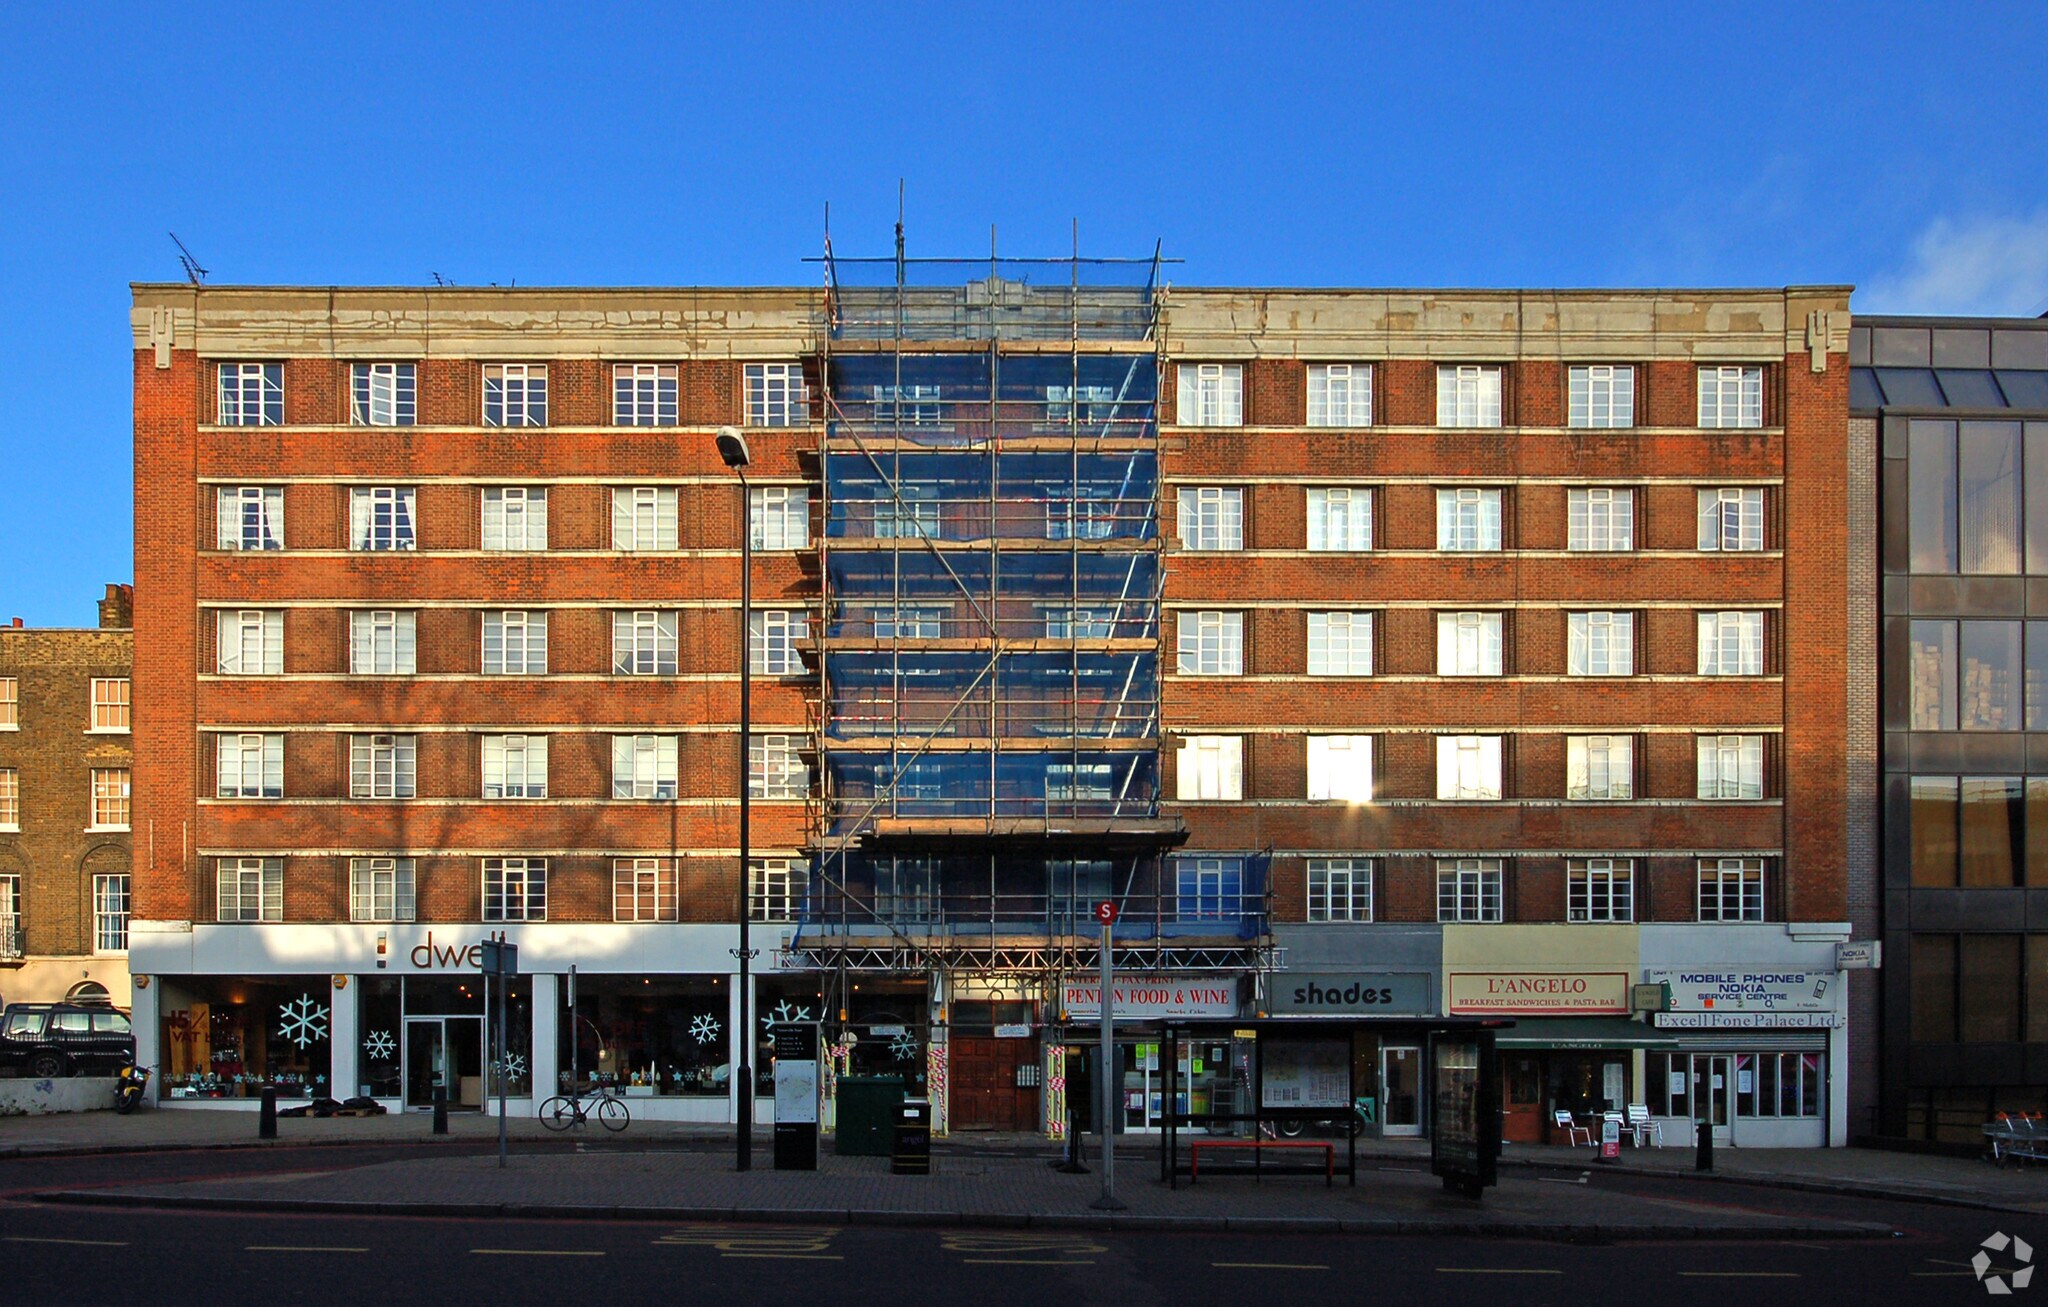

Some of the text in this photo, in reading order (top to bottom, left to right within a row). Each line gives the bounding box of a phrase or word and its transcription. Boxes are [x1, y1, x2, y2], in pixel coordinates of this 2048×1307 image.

[1101, 904, 1111, 918] S
[411, 930, 505, 968] dwe
[1681, 974, 1805, 983] MOBILE PHONES
[1294, 982, 1393, 1004] shades
[1488, 979, 1586, 993] L'ANGELO
[1719, 984, 1766, 993] NOKIA
[1067, 989, 1230, 1004] PENTN FOOD & WINE
[1659, 1013, 1707, 1026] Excell
[1712, 1013, 1751, 1026] Fone
[1754, 1013, 1804, 1026] Palace
